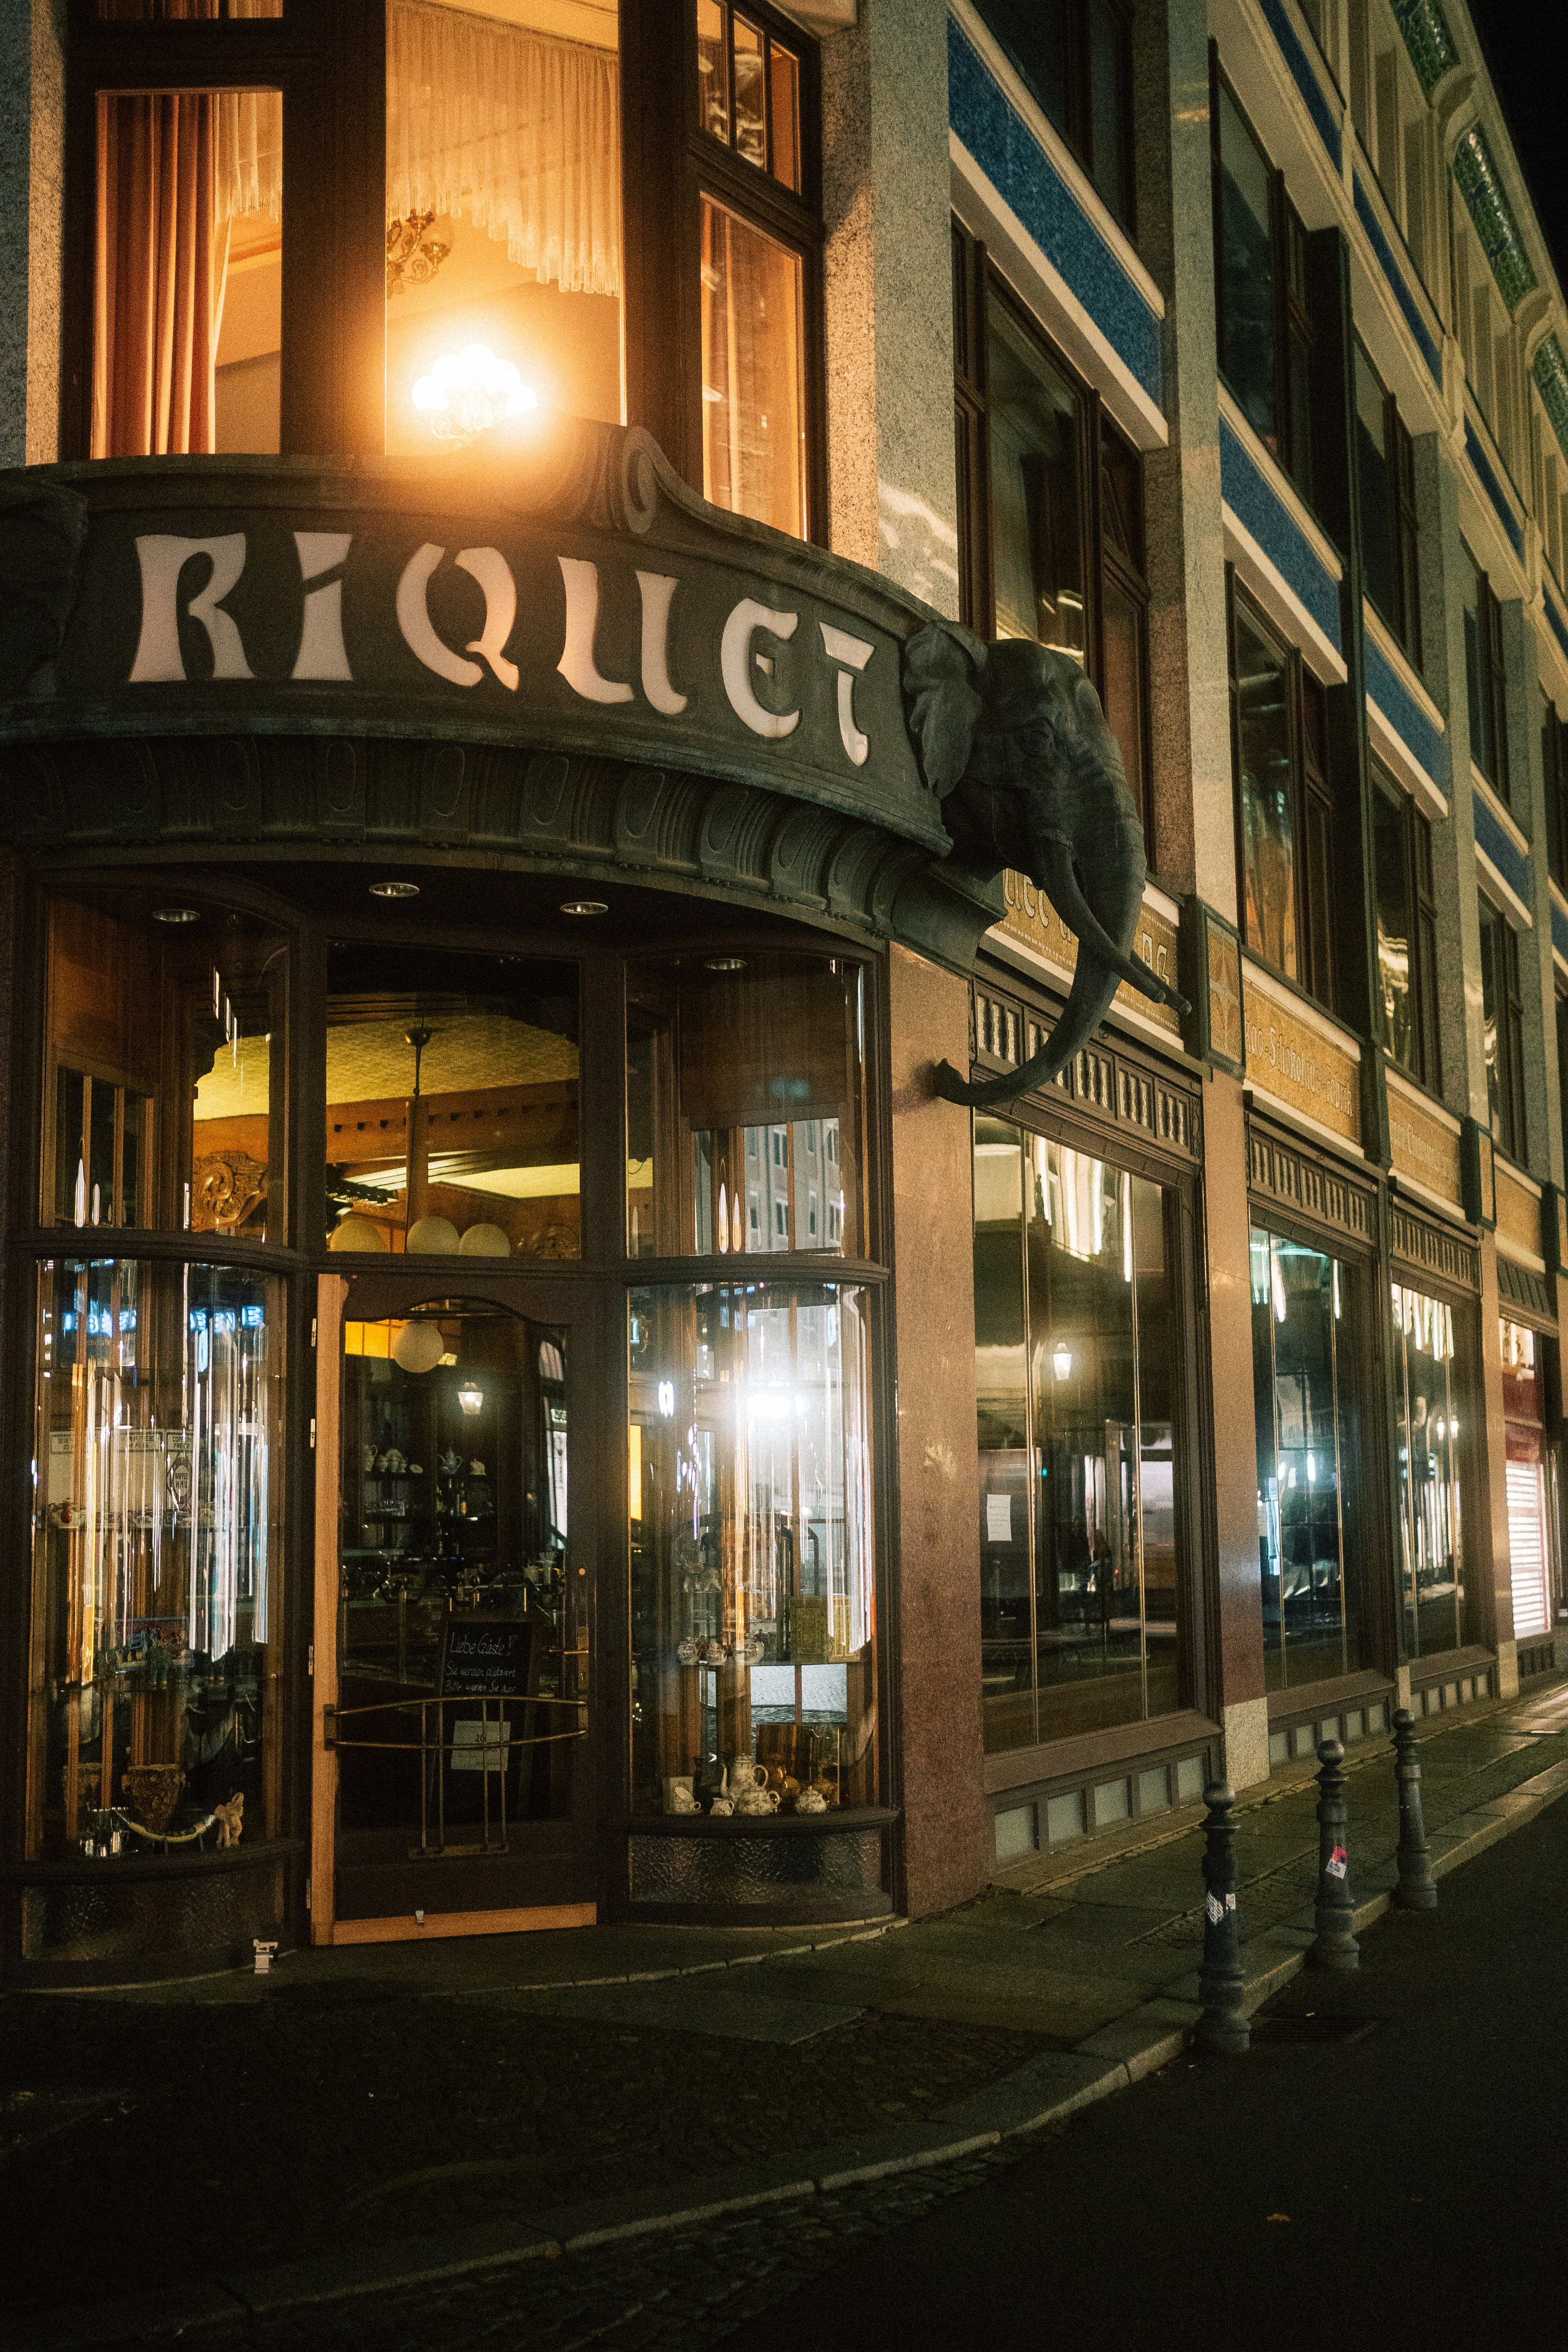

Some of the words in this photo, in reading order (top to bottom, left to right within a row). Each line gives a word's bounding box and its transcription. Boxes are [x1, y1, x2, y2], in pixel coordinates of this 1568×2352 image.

[128, 531, 875, 766] RIQUET
[450, 1632, 476, 1654] Liebe
[446, 1660, 458, 1675] Sie
[460, 1667, 484, 1676] werden
[445, 1679, 462, 1692] Bitte
[465, 1683, 487, 1691] warten
[489, 1680, 499, 1692] Sie
[501, 1684, 516, 1693] hier
